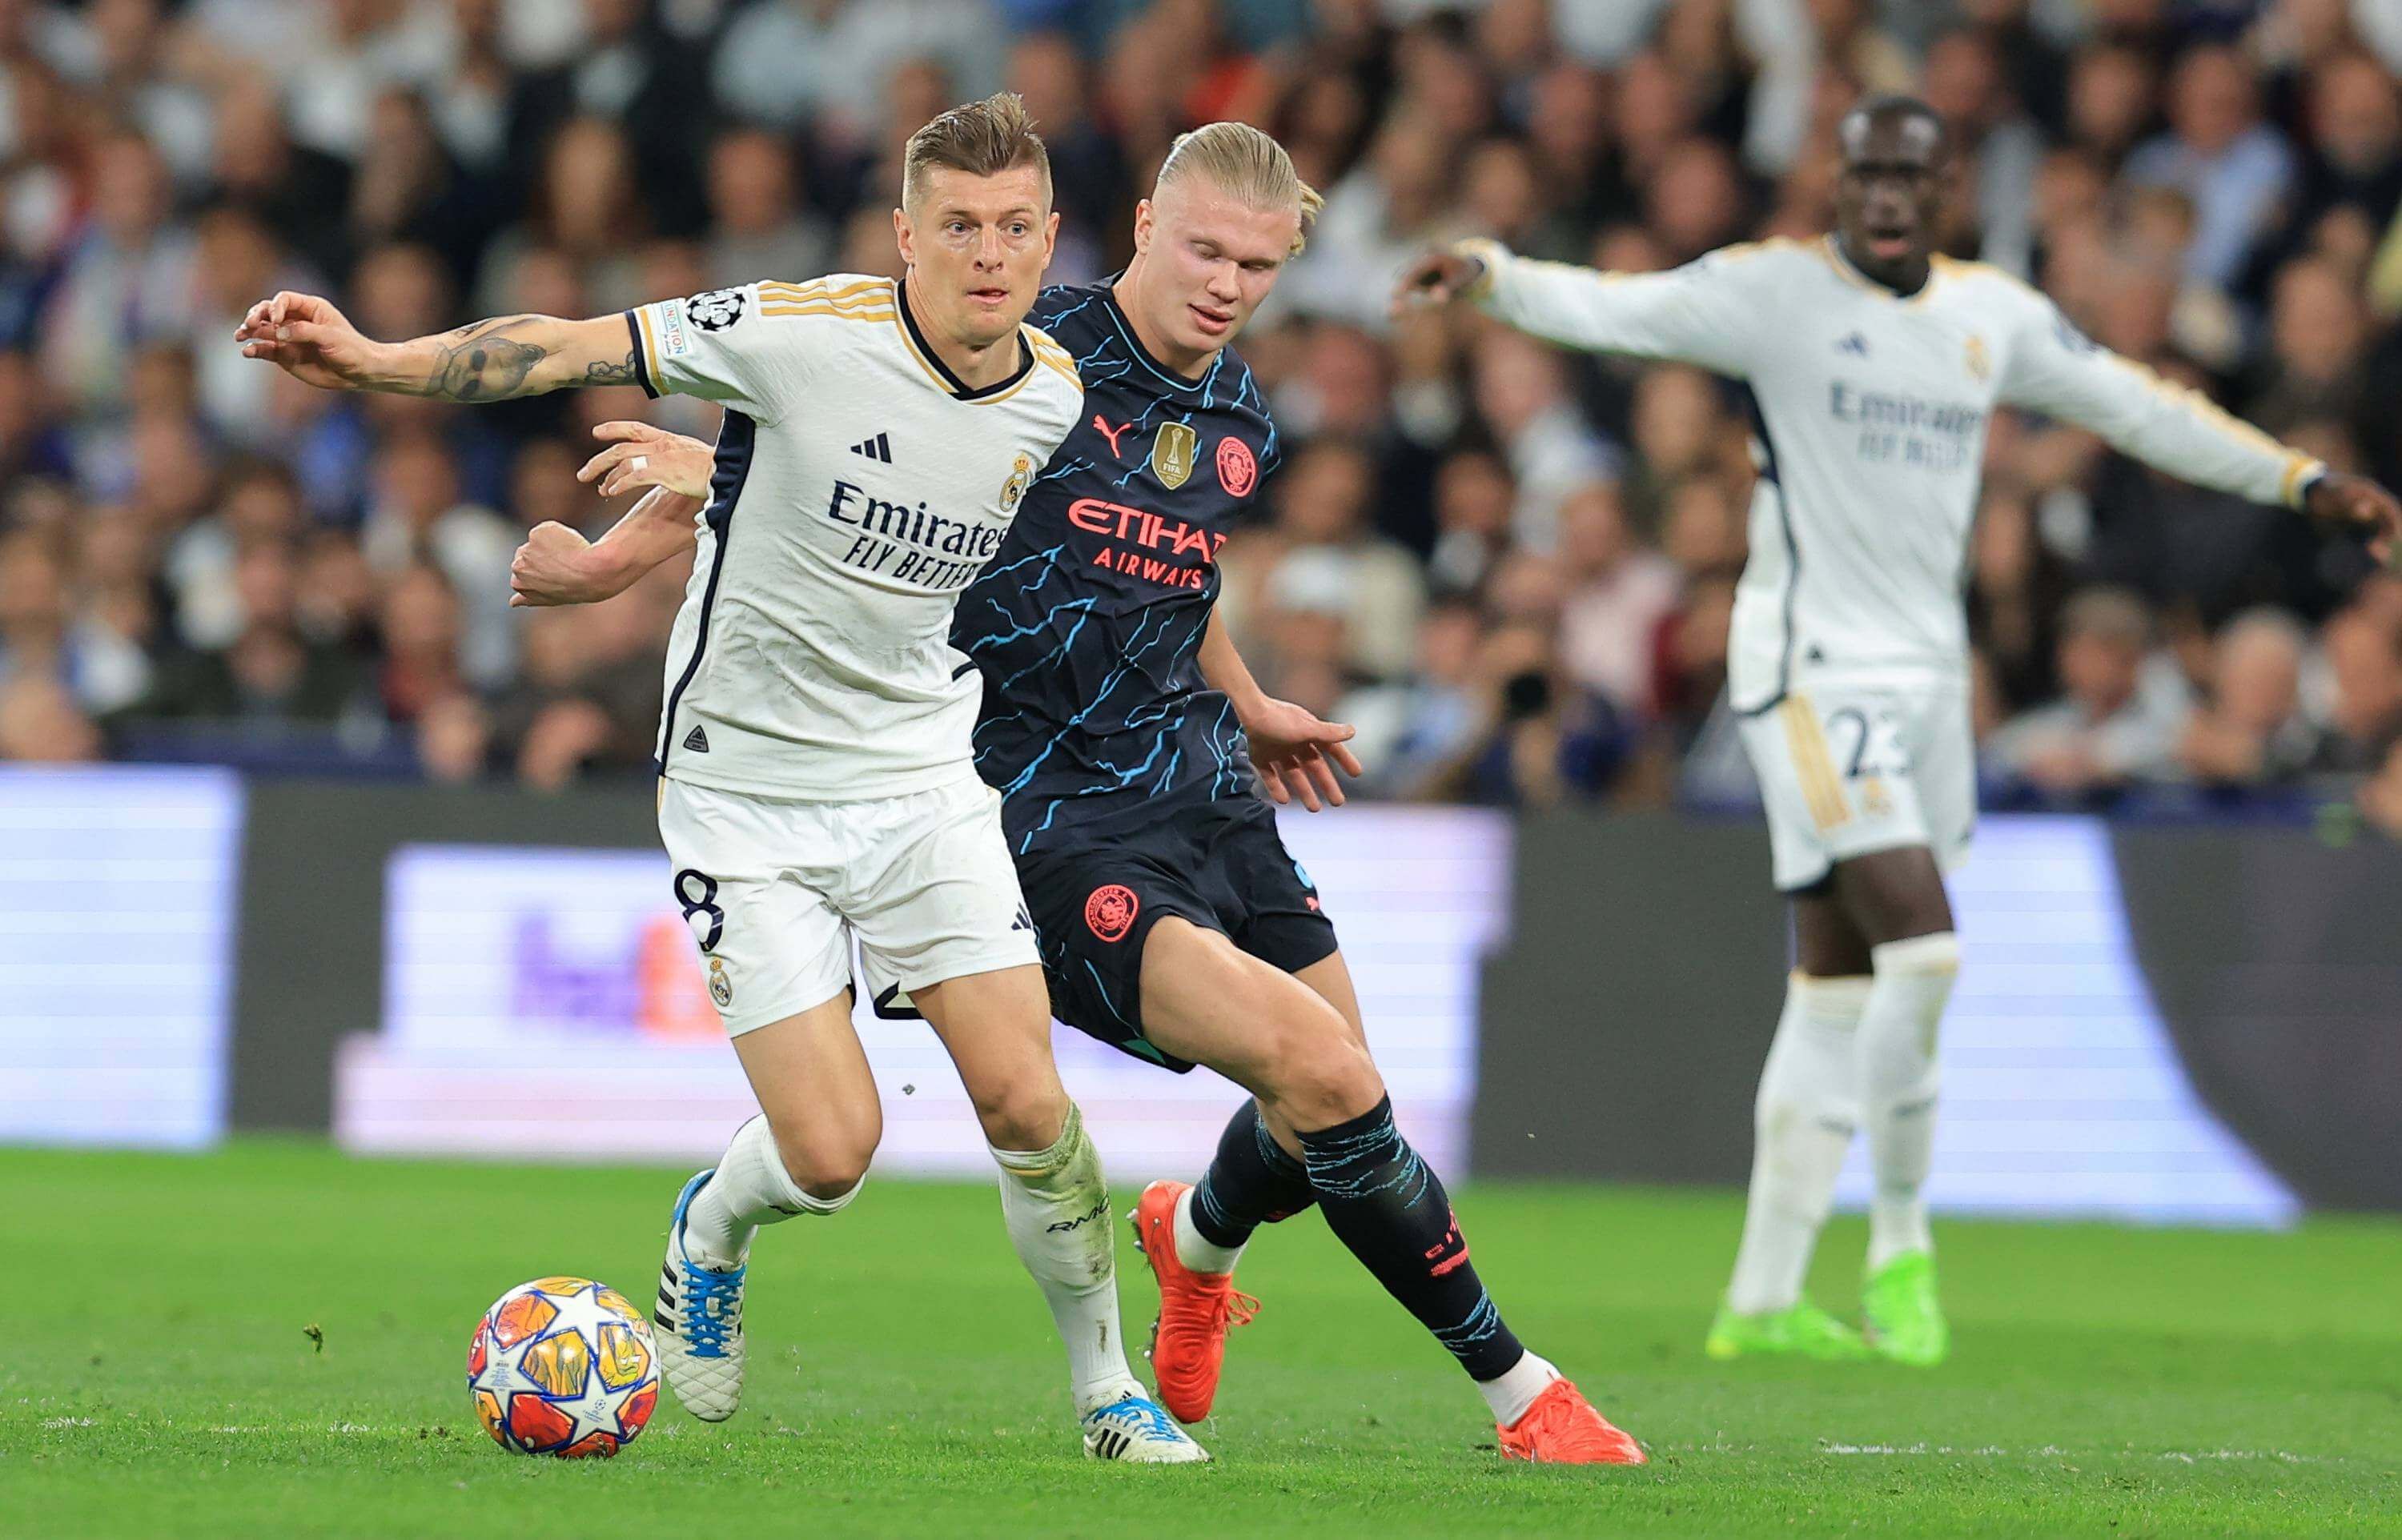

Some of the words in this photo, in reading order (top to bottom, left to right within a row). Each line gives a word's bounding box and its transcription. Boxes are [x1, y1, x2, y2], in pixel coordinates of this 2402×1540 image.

[665, 303, 685, 354] UNDATION
[1163, 463, 1182, 475] FIFA
[843, 536, 896, 571] FLY
[1093, 547, 1202, 590] AIRWAYS
[674, 868, 725, 952] 8
[1046, 1190, 1111, 1233] RMC
